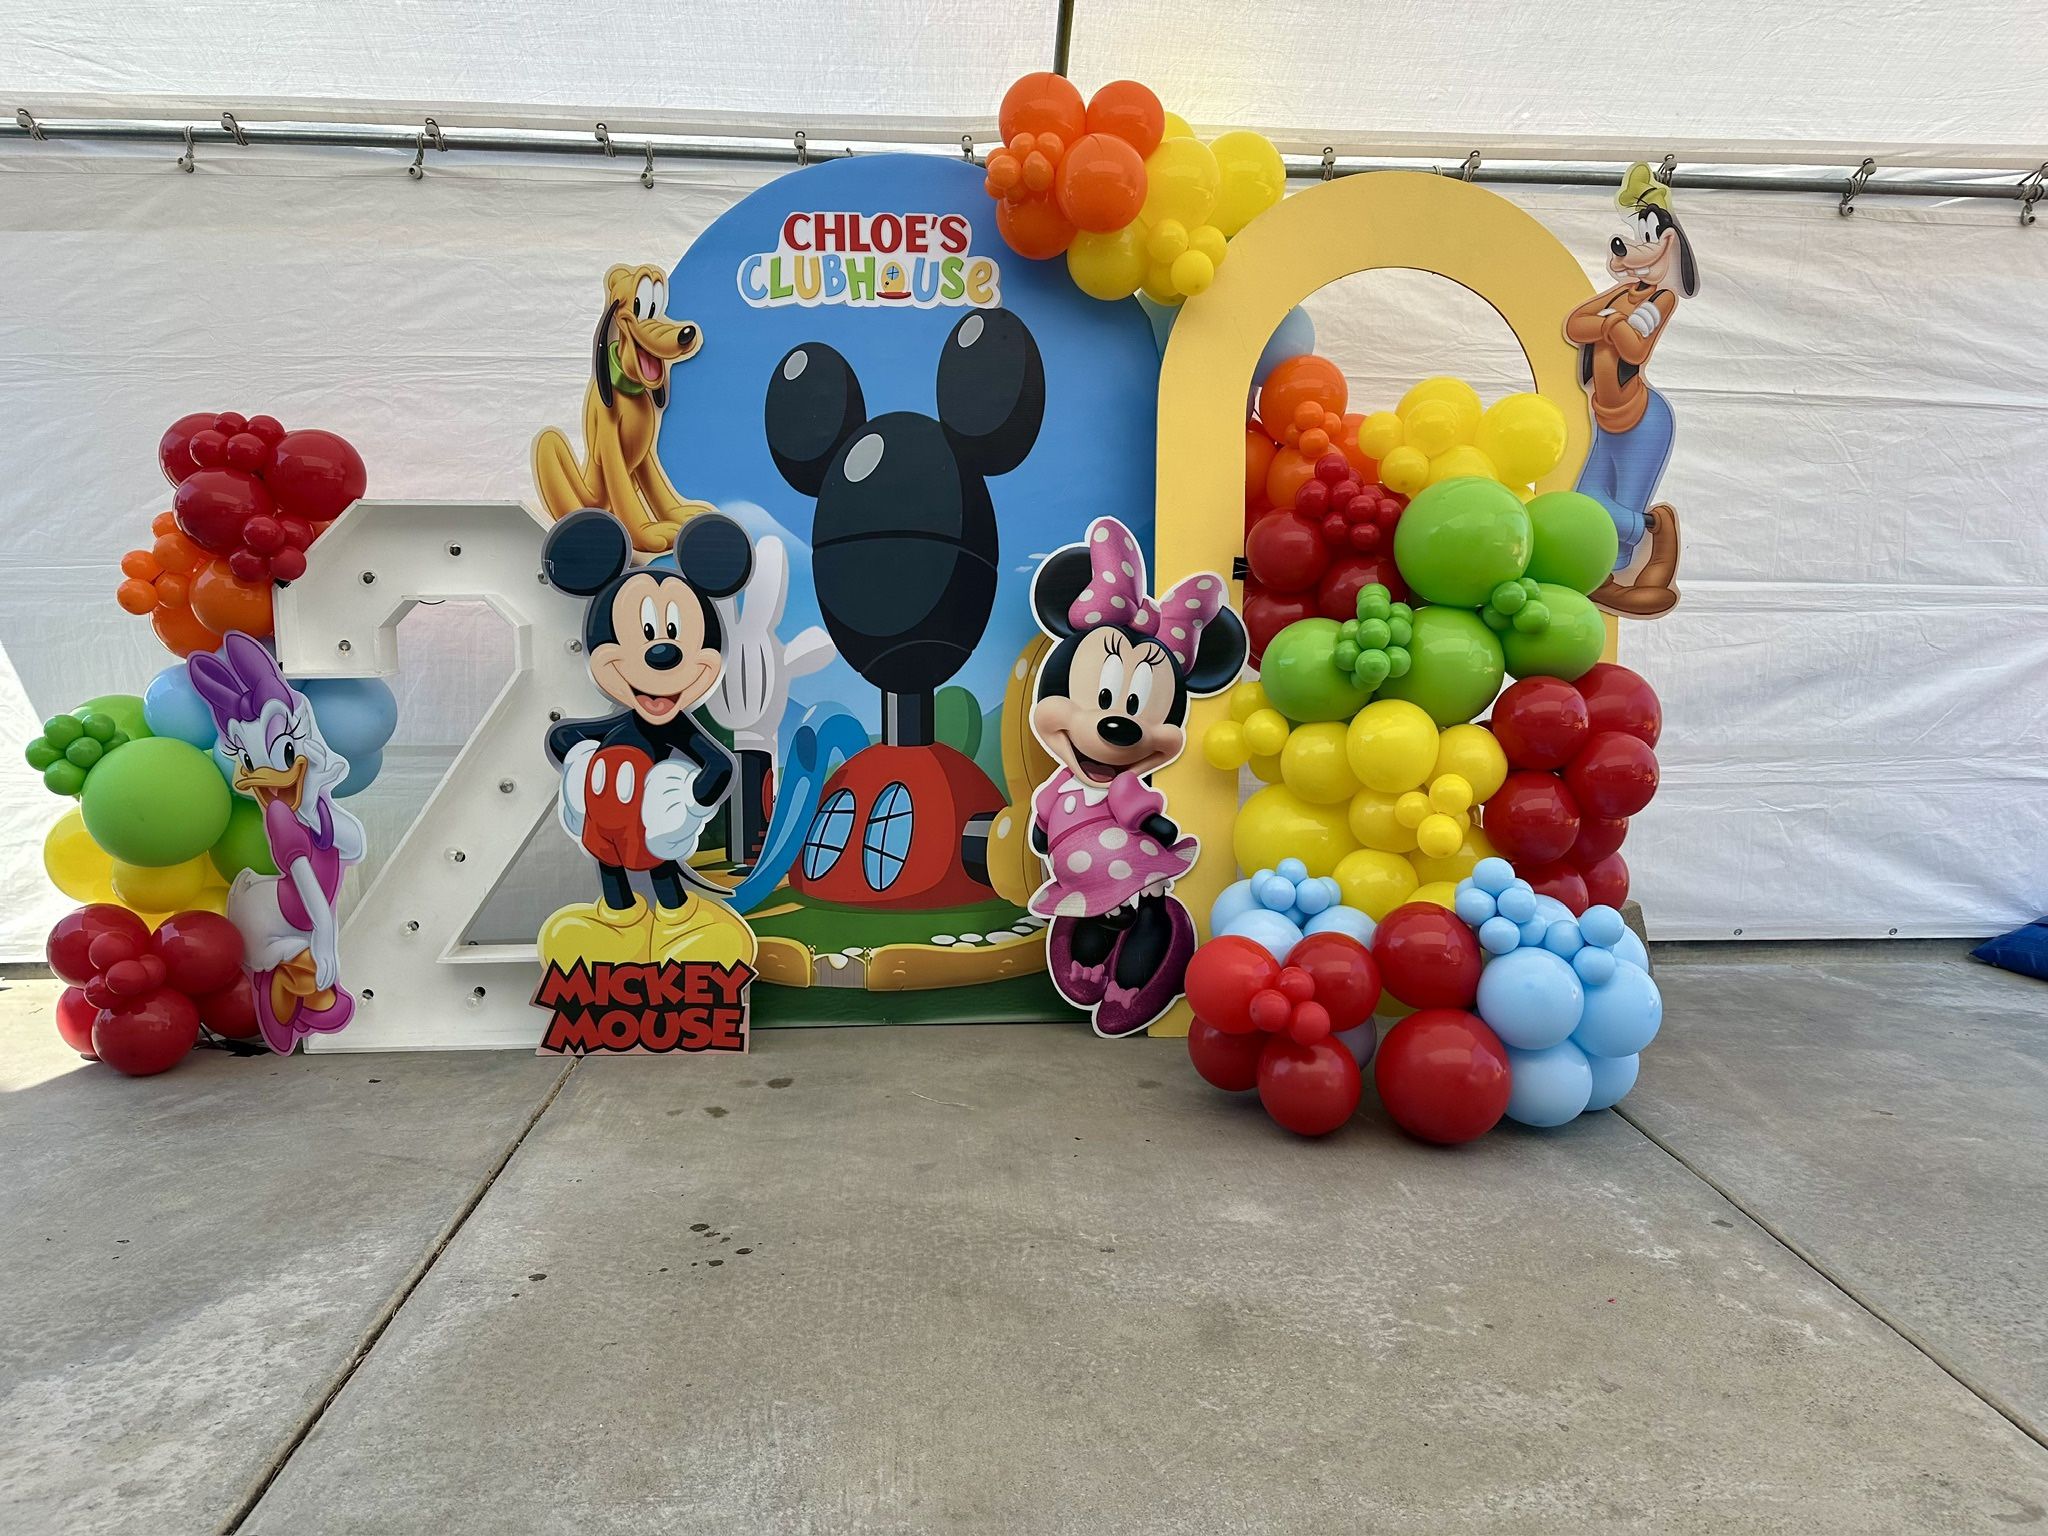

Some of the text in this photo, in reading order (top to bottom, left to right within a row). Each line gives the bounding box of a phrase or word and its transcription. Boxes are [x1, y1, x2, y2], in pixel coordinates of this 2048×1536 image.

[783, 213, 968, 254] CHLOE'S
[273, 498, 592, 1055] 2
[539, 961, 751, 1007] MICKEY
[545, 1007, 742, 1051] MOUSE
